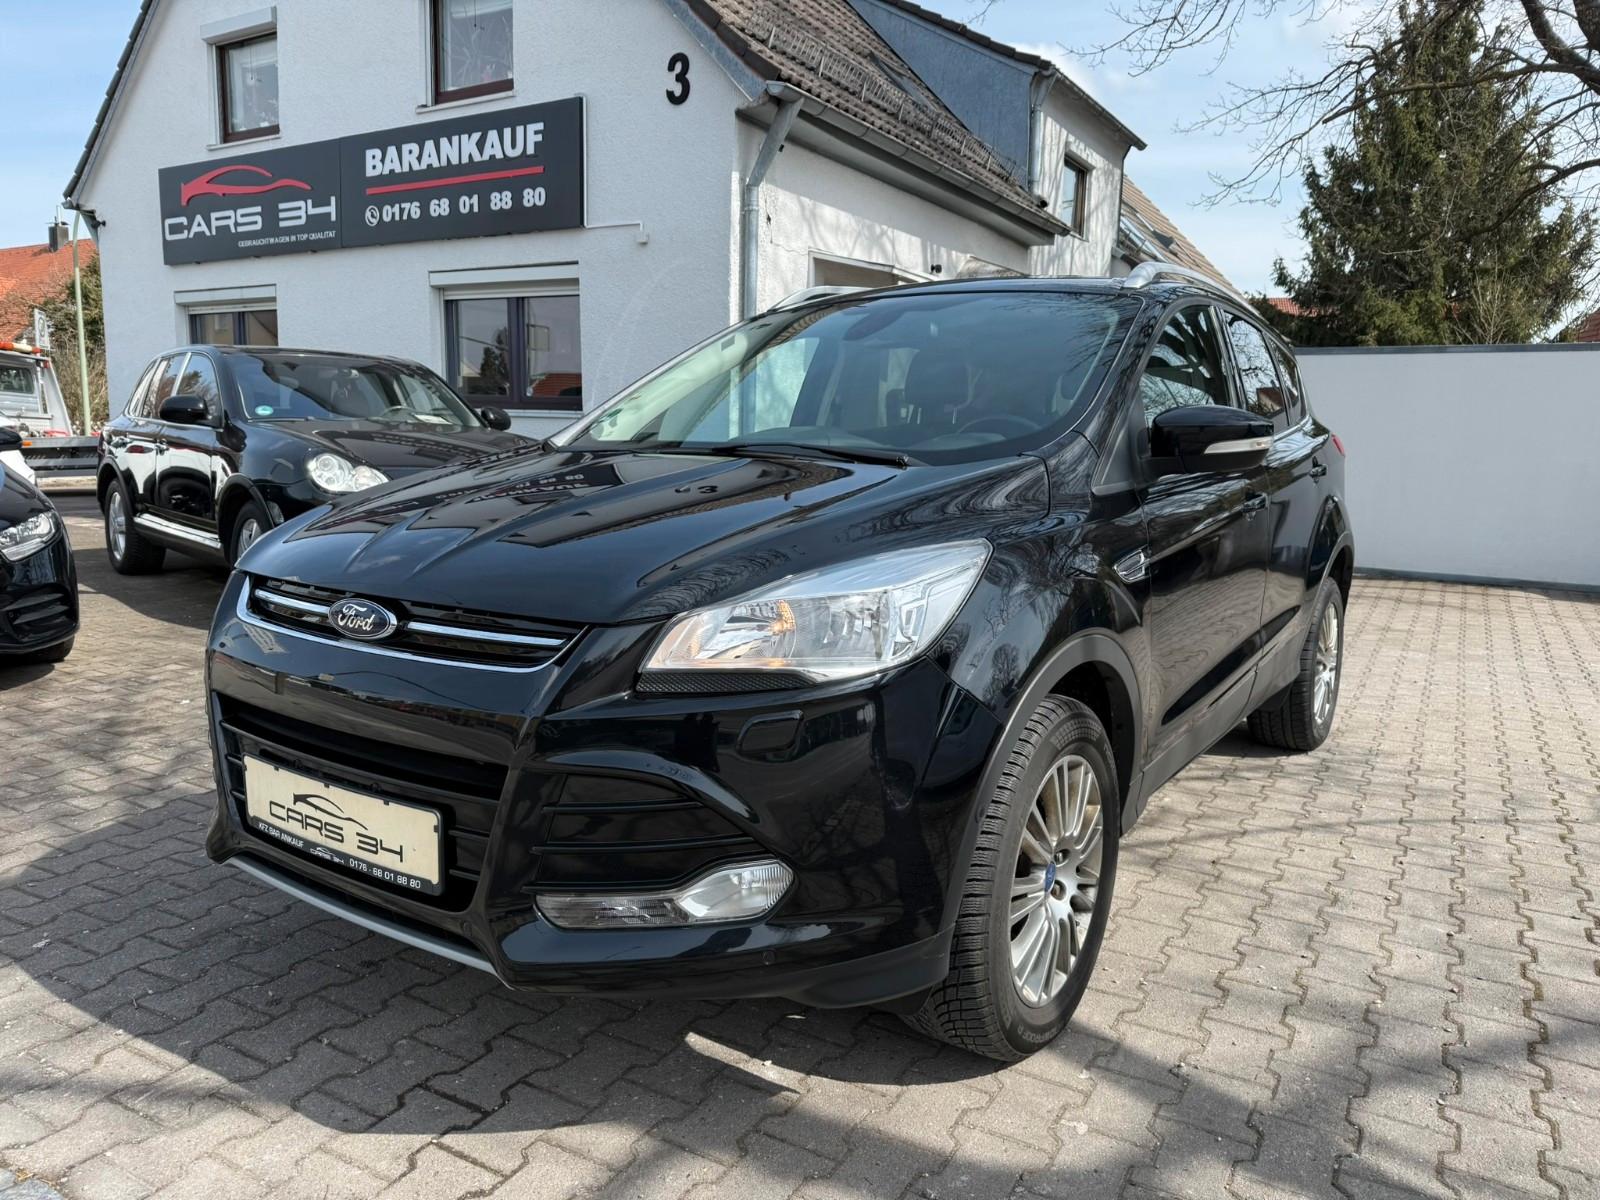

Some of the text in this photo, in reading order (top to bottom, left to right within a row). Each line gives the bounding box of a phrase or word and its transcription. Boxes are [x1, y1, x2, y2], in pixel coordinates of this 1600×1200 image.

[666, 52, 690, 105] 3
[365, 122, 545, 177] BARANKAUF
[164, 196, 336, 241] CARS 34
[382, 187, 546, 222] 0176 68 01 88 80
[238, 236, 290, 247] GEBRAUCHTWAGEN
[297, 233, 308, 241] TOP
[337, 603, 376, 631] Ford
[268, 826, 280, 838] BAR
[280, 832, 304, 848] ANKAUF
[269, 800, 403, 863] CARS 34
[384, 871, 394, 881] 01
[409, 879, 421, 889] 80
